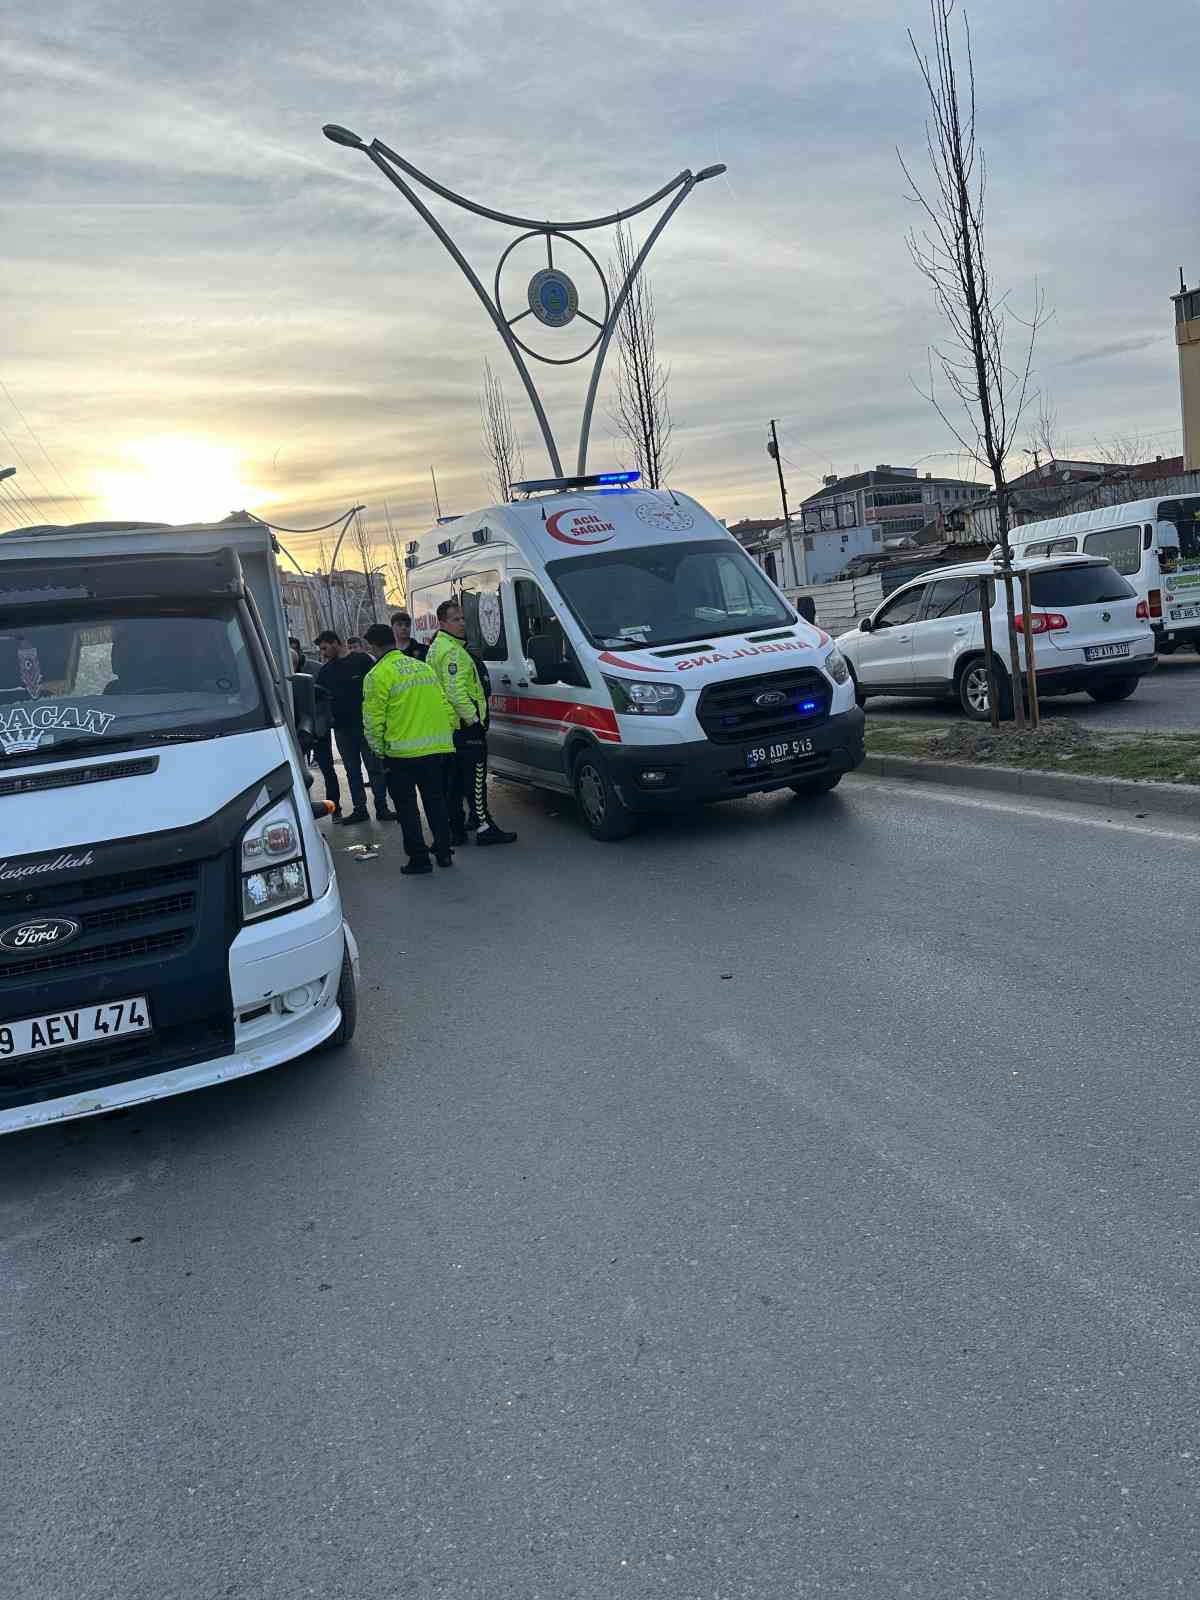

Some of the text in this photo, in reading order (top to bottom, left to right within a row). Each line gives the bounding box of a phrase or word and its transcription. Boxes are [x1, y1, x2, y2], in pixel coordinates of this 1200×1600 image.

[752, 748, 766, 761] 59
[770, 743, 789, 758] ADP
[15, 923, 59, 945] Ford
[31, 1013, 80, 1049] AEV
[94, 1001, 145, 1034] 474
